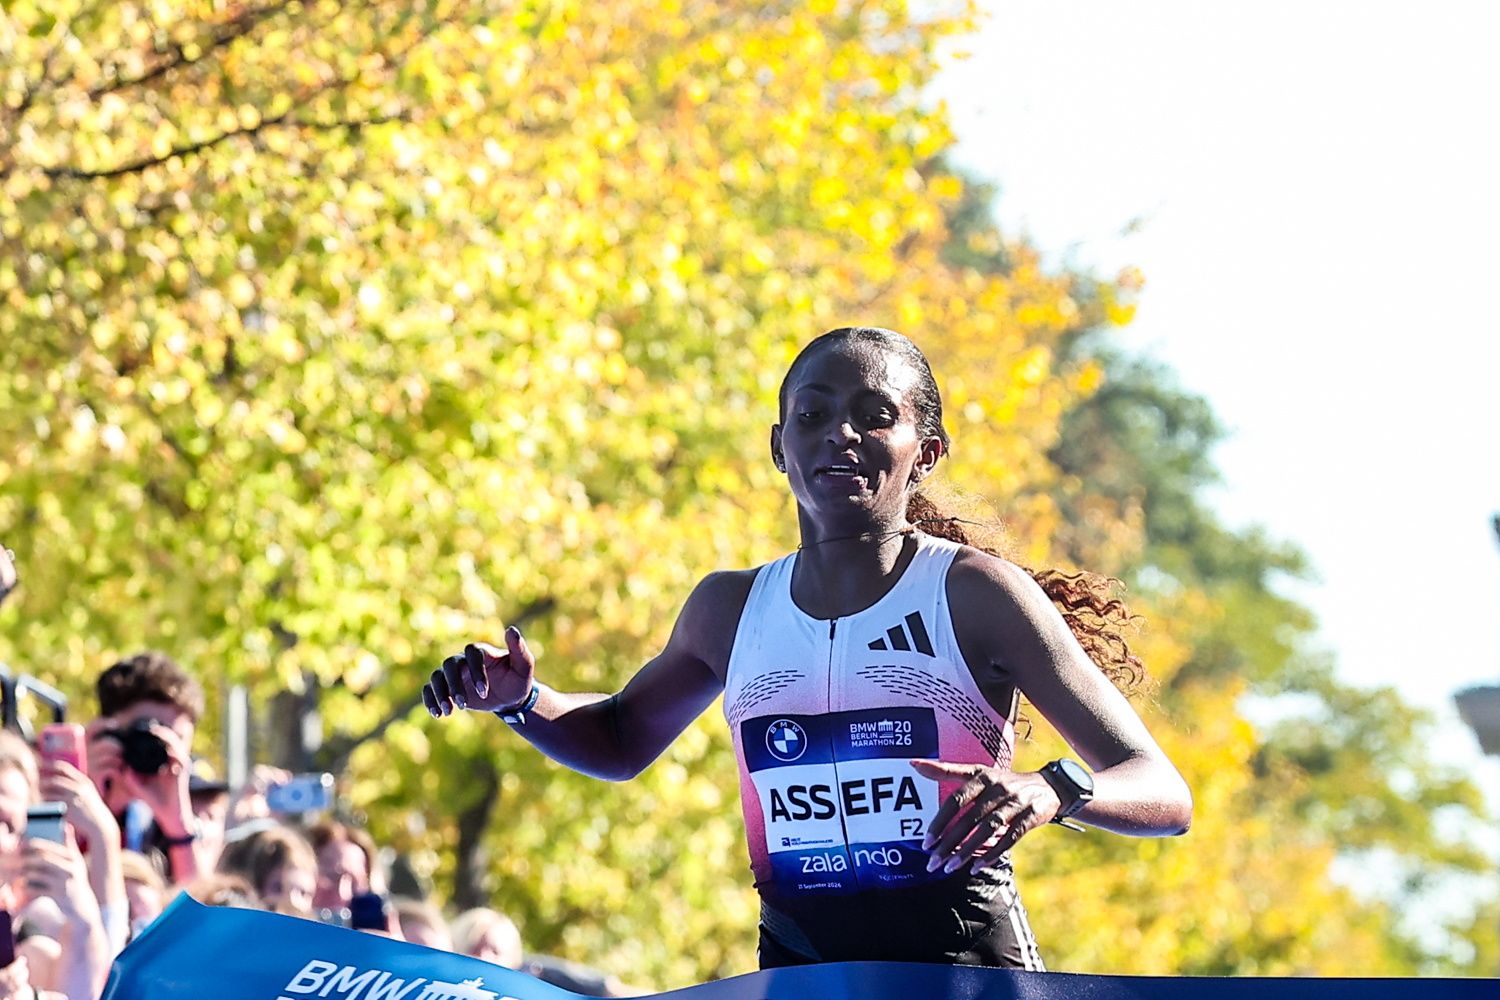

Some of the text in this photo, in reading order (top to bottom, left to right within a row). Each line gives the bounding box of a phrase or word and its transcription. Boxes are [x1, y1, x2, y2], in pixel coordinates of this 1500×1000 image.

[770, 721, 800, 734] BMW
[850, 722, 877, 733] BMW
[894, 720, 911, 733] 20
[851, 732, 878, 740] BERLIN
[895, 733, 912, 746] 26
[851, 739, 895, 748] MARATHON
[769, 776, 923, 823] ASSEFA
[900, 818, 924, 836] F2
[800, 847, 902, 874] zalando
